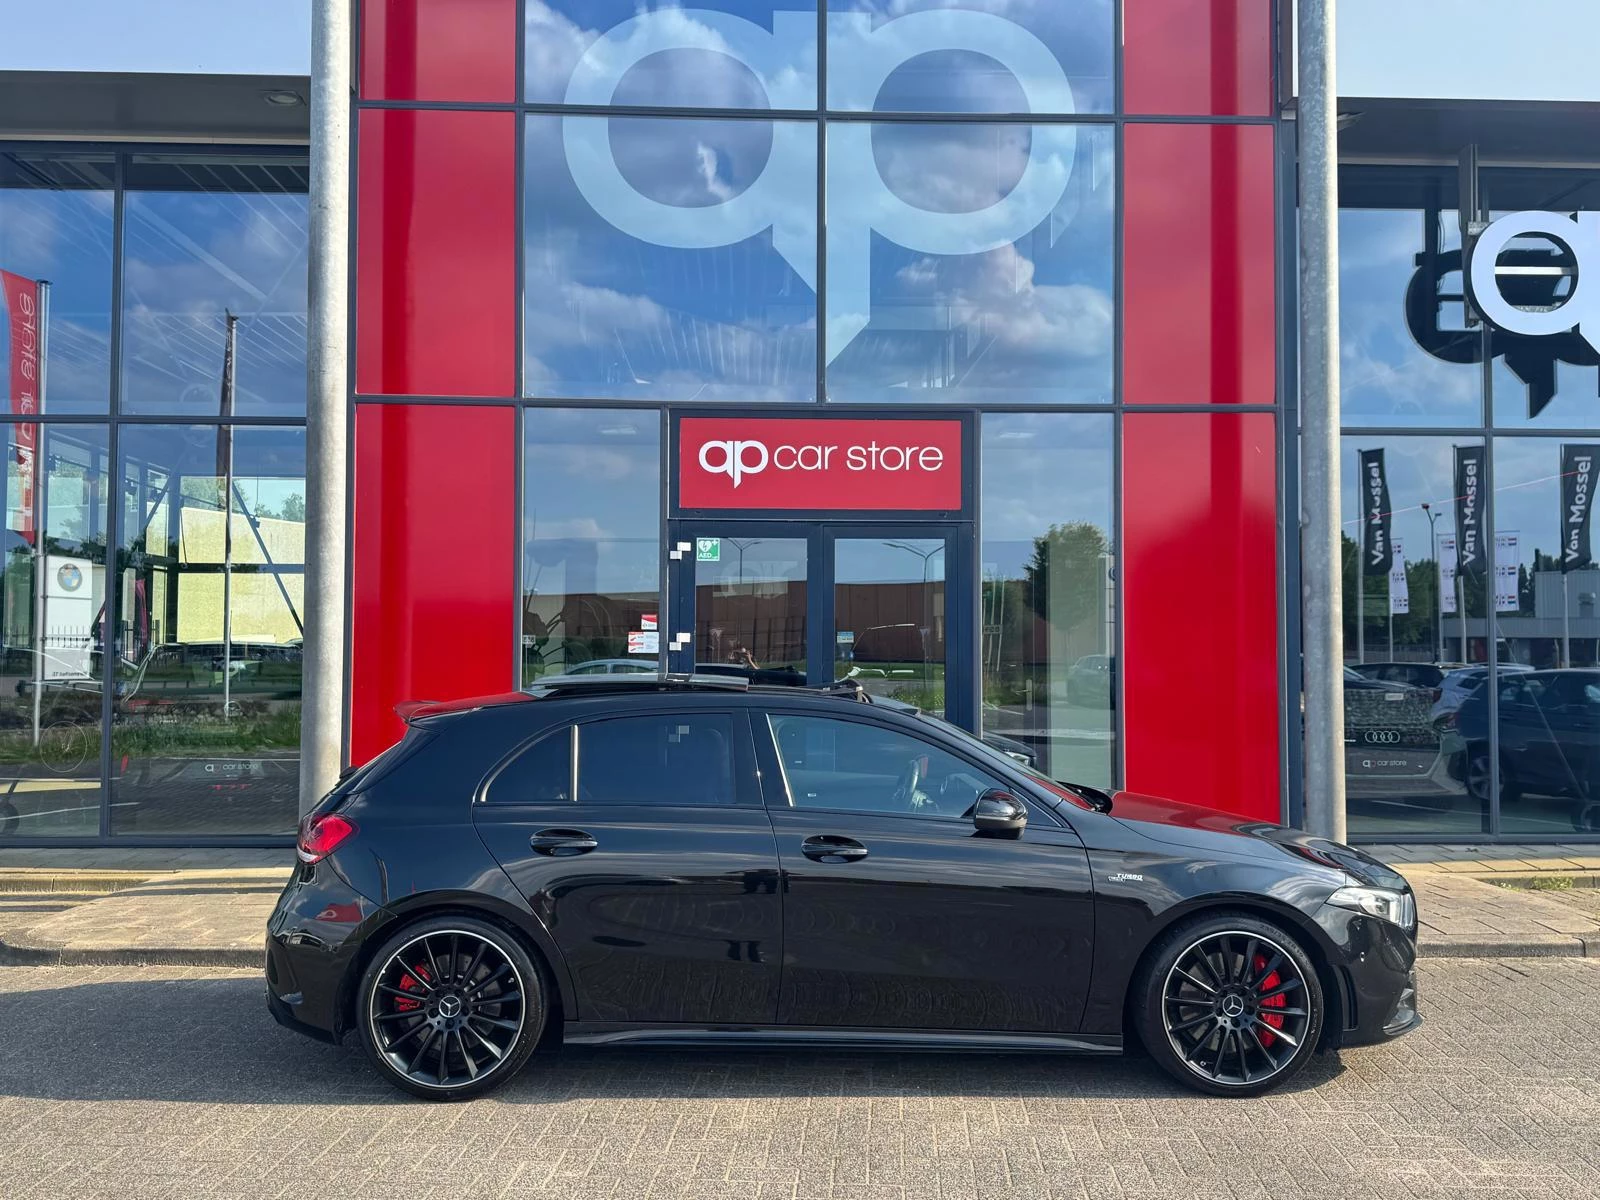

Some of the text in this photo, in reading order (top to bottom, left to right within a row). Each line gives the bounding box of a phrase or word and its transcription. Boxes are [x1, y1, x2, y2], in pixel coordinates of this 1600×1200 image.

[698, 440, 943, 488] ap car store
[1367, 462, 1385, 565] Van Mossel
[1462, 458, 1477, 566] Van Mossel
[1564, 455, 1592, 563] Van Mossel
